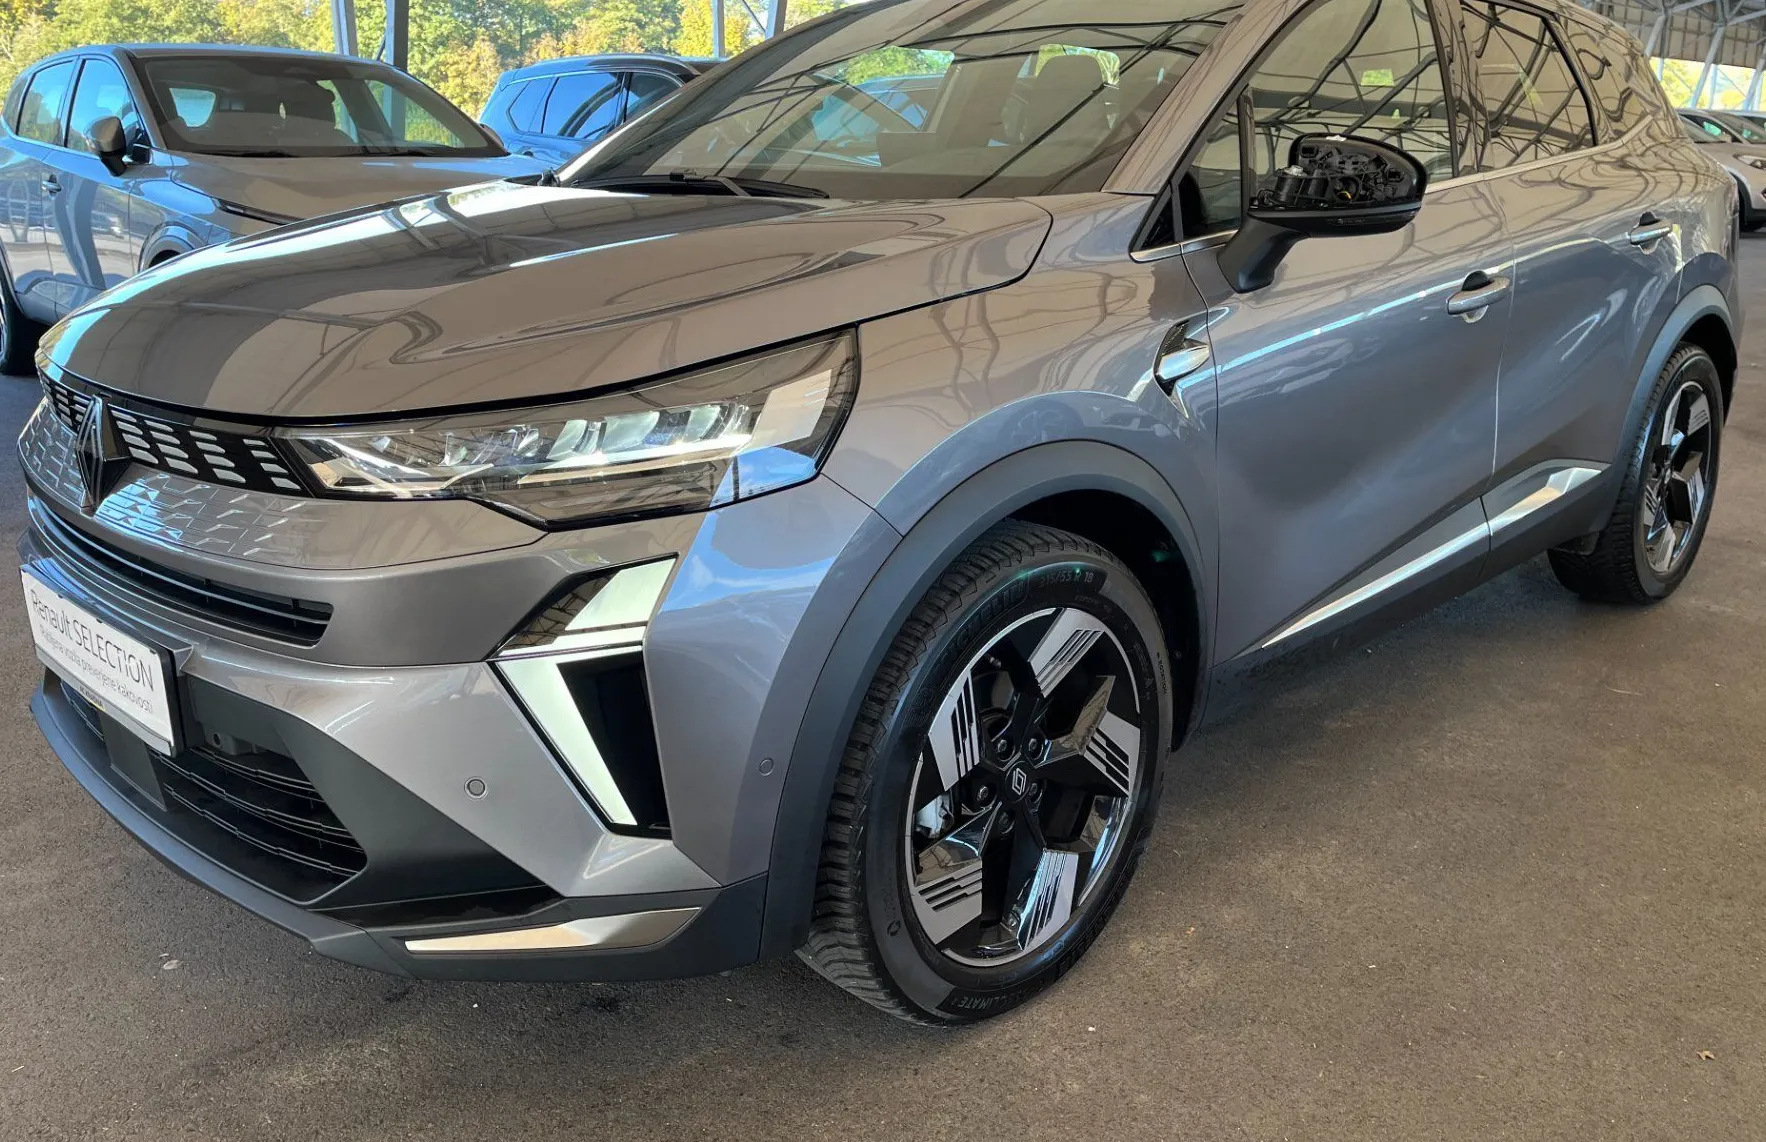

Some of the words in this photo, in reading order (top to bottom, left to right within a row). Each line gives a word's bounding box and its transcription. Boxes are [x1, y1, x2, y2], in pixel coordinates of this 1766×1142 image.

[1083, 571, 1095, 583] 18
[30, 588, 73, 641] Renault
[73, 619, 154, 692] SELECTION
